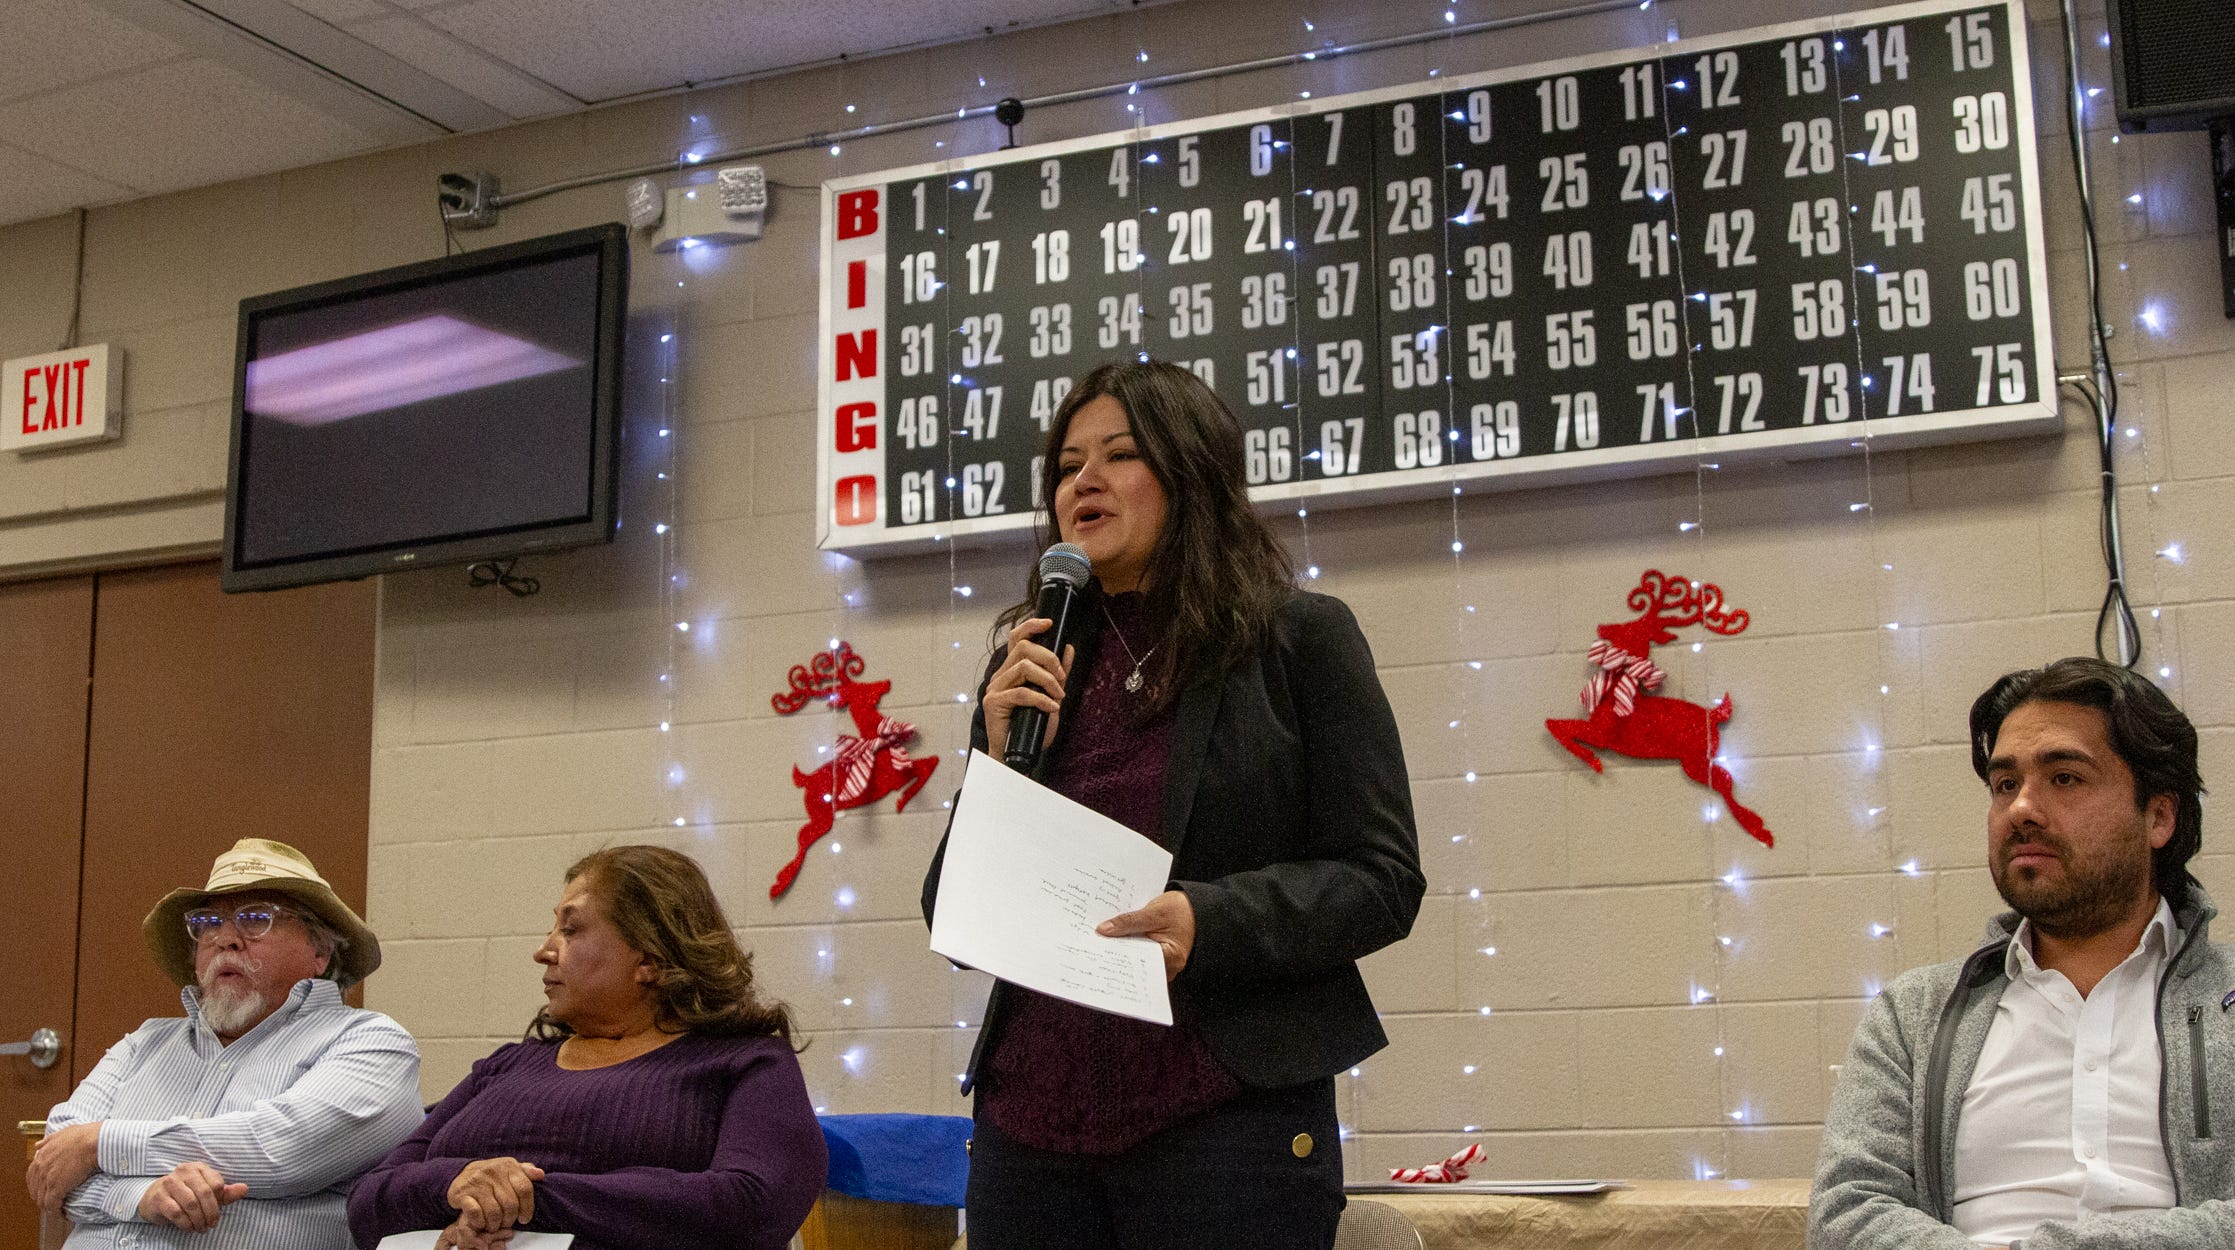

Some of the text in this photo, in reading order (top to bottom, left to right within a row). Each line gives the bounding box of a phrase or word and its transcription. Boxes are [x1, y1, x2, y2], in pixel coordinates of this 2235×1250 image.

[900, 92, 2009, 304] 16 17 18 19 20 21 22 23 24 25 26 27 28 29 30
[913, 12, 1993, 231] 1 2 3 4 5 6 7 8 9 10 11 12 13 14 15
[897, 395, 938, 449] 46
[963, 386, 1002, 440] 47
[1247, 349, 1284, 405] 51
[1317, 340, 1364, 396] 52
[1391, 328, 1439, 389] 53
[1467, 320, 1516, 379] 54
[1546, 310, 1596, 369] 55
[1626, 300, 1677, 360] 56
[1710, 289, 1757, 350] 57
[1792, 279, 1845, 340] 58
[1876, 269, 1930, 330] 59
[1964, 258, 2020, 320] 60
[901, 173, 2015, 376] 31 32 33 34 35 36 37 38 39 40 41 42 43 44 45
[22, 358, 90, 434] EXIT
[901, 470, 935, 523] 61
[963, 461, 1004, 516] 62
[1245, 427, 1291, 484] 66
[1320, 418, 1364, 477] 67
[1394, 411, 1442, 469] 68
[1471, 401, 1520, 460] 69
[1551, 392, 1599, 451] 70
[1638, 382, 1676, 440] 71
[1714, 373, 1765, 433] 72
[1799, 363, 1849, 424] 73
[1883, 353, 1935, 415] 74
[1972, 343, 2026, 406] 75
